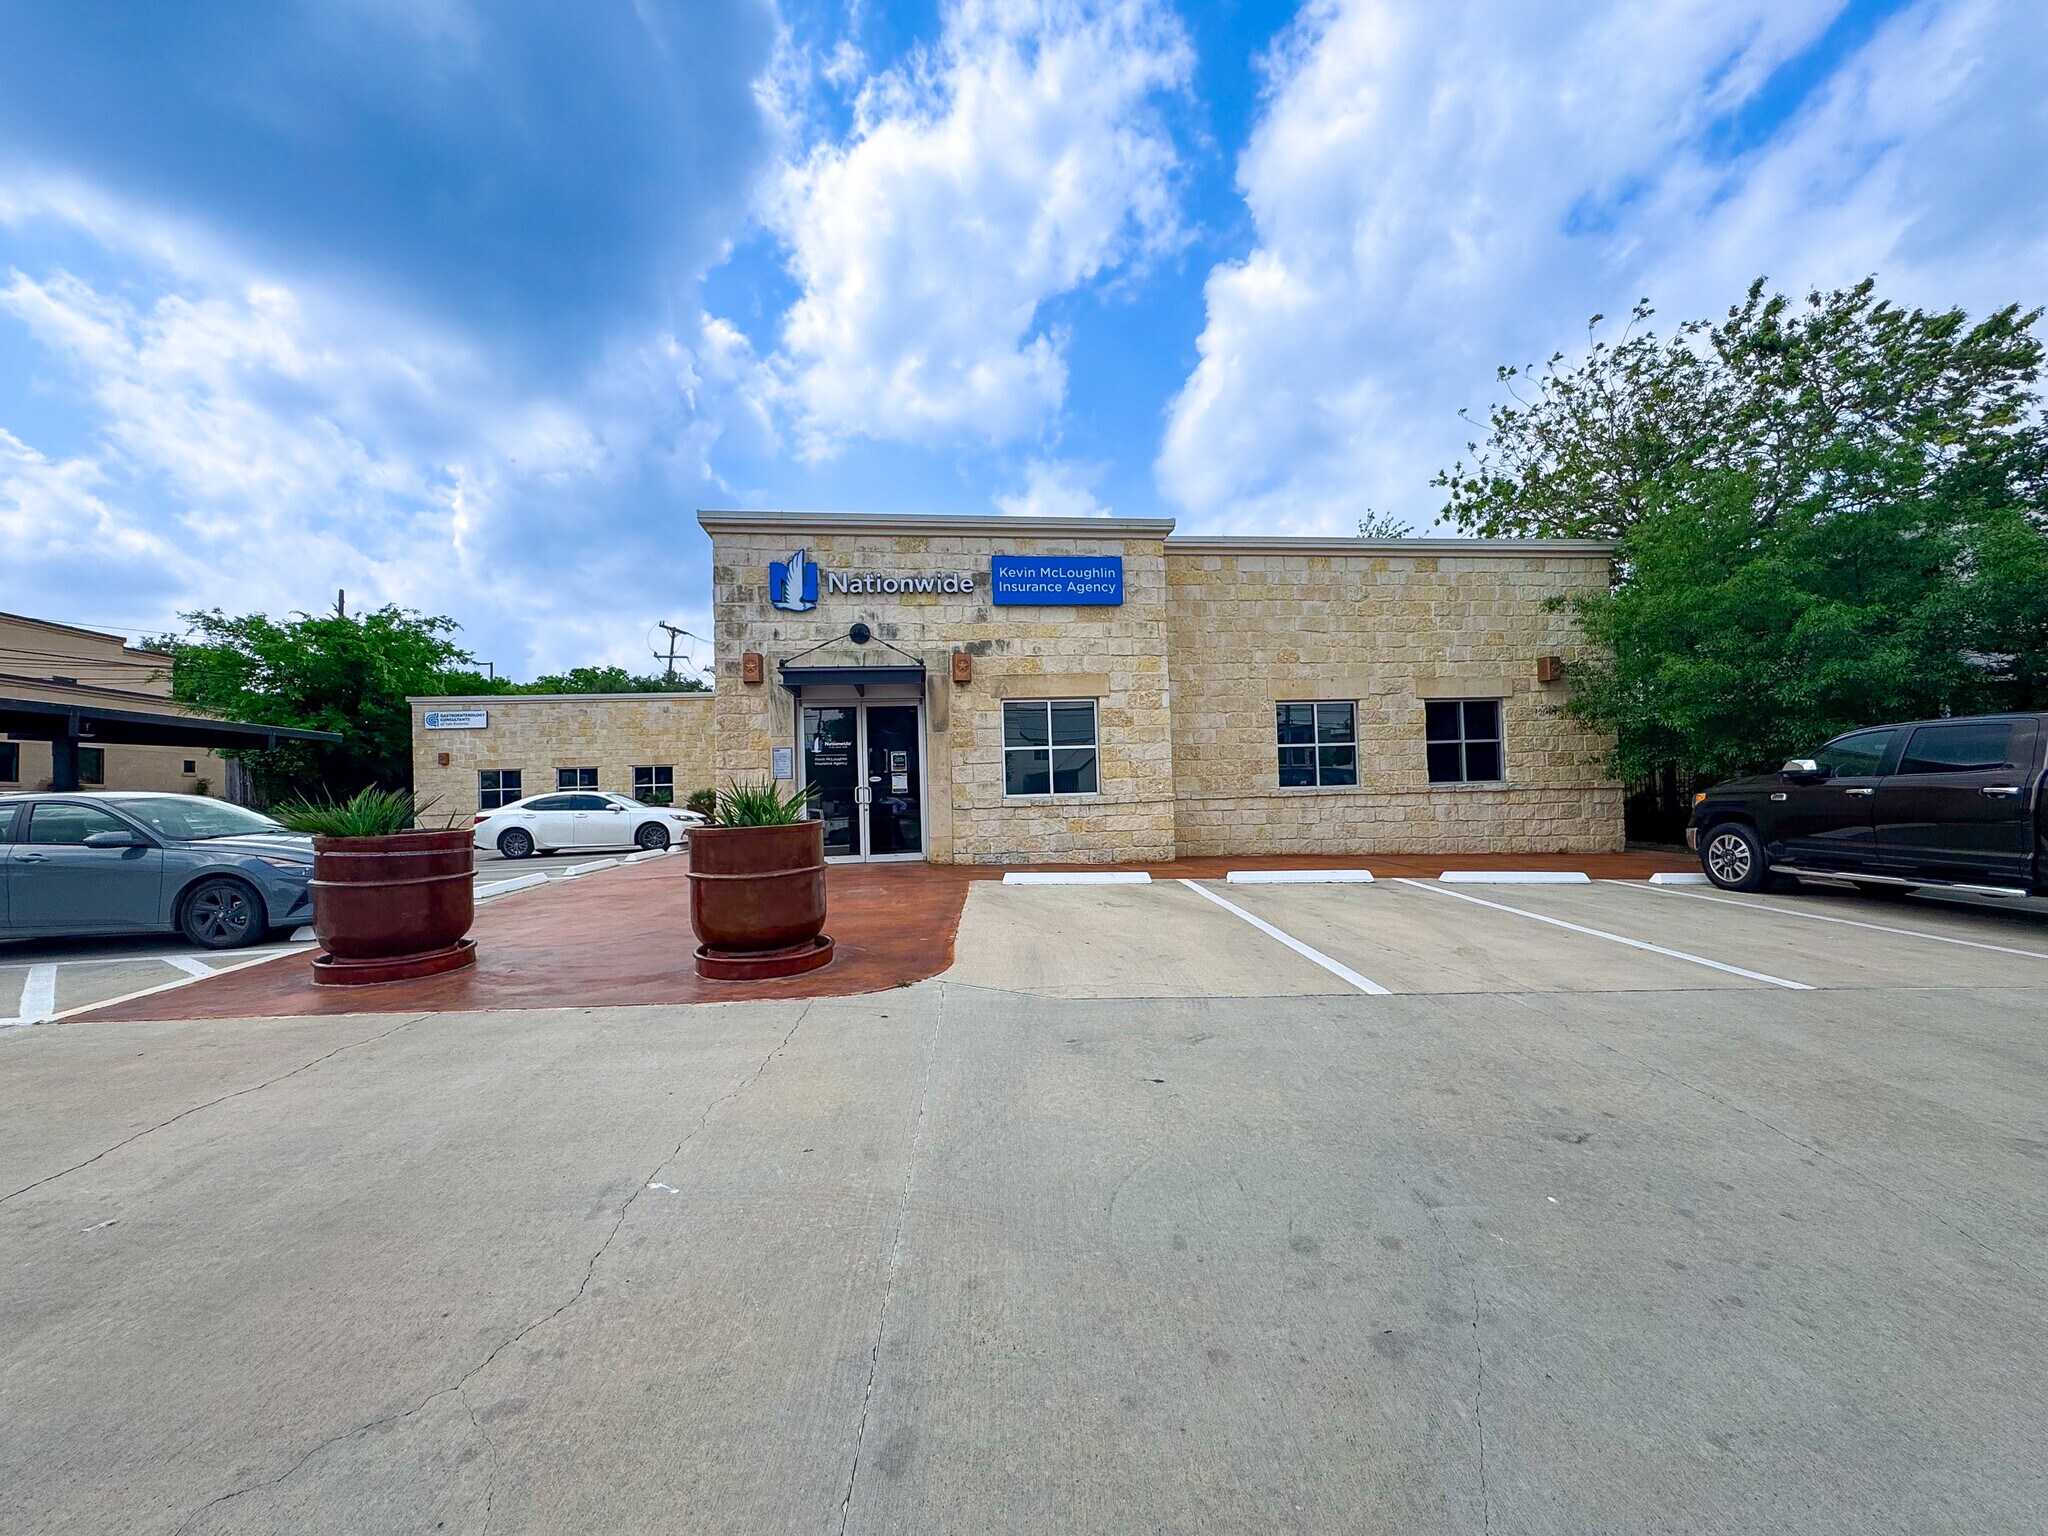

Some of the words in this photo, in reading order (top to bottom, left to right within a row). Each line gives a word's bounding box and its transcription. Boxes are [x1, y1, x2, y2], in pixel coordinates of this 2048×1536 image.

[999, 567, 1036, 578] Kevin
[1040, 567, 1116, 580] McLoughlin
[828, 572, 975, 595] Nationwide
[999, 581, 1062, 592] Insurance
[1066, 581, 1116, 594] Agency
